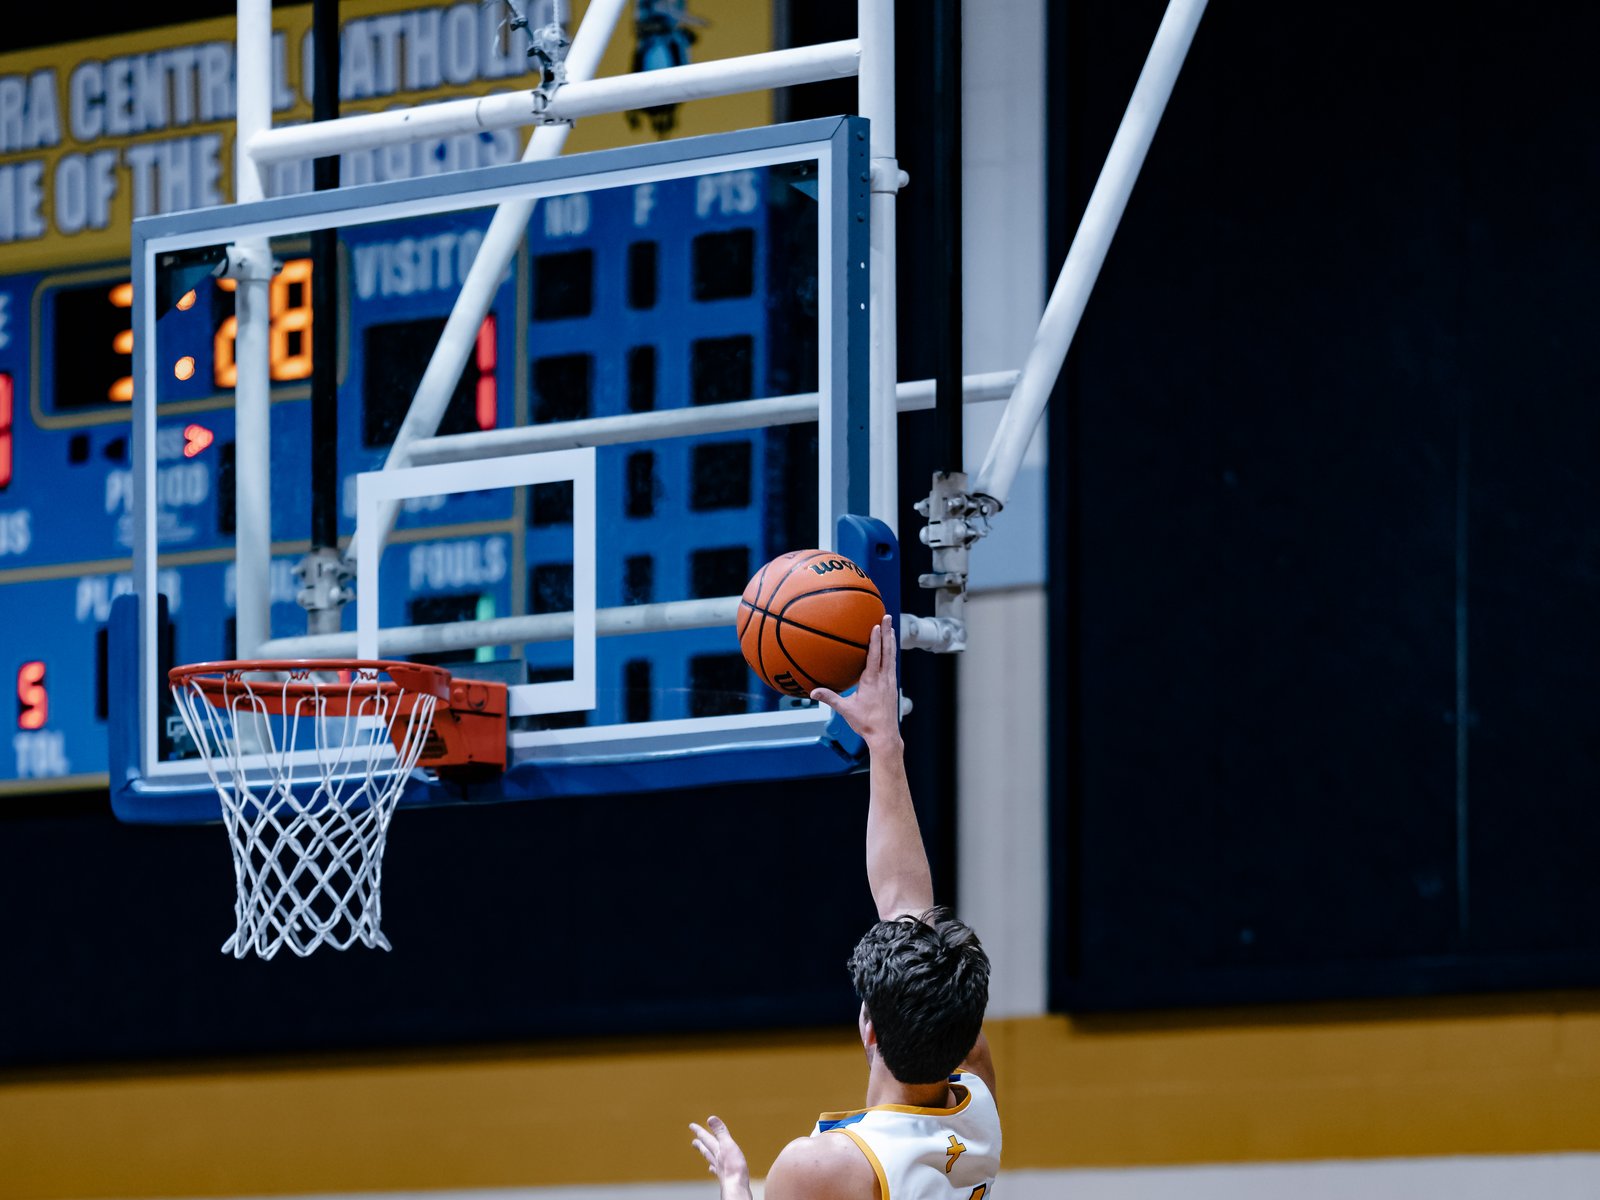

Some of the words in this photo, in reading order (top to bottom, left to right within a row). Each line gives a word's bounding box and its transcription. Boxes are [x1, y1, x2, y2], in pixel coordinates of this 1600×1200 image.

[55, 148, 118, 233] OF
[126, 133, 222, 216] THE
[544, 193, 589, 237] NO
[633, 184, 654, 226] F
[696, 171, 758, 217] PTS
[410, 537, 507, 590] FOULS
